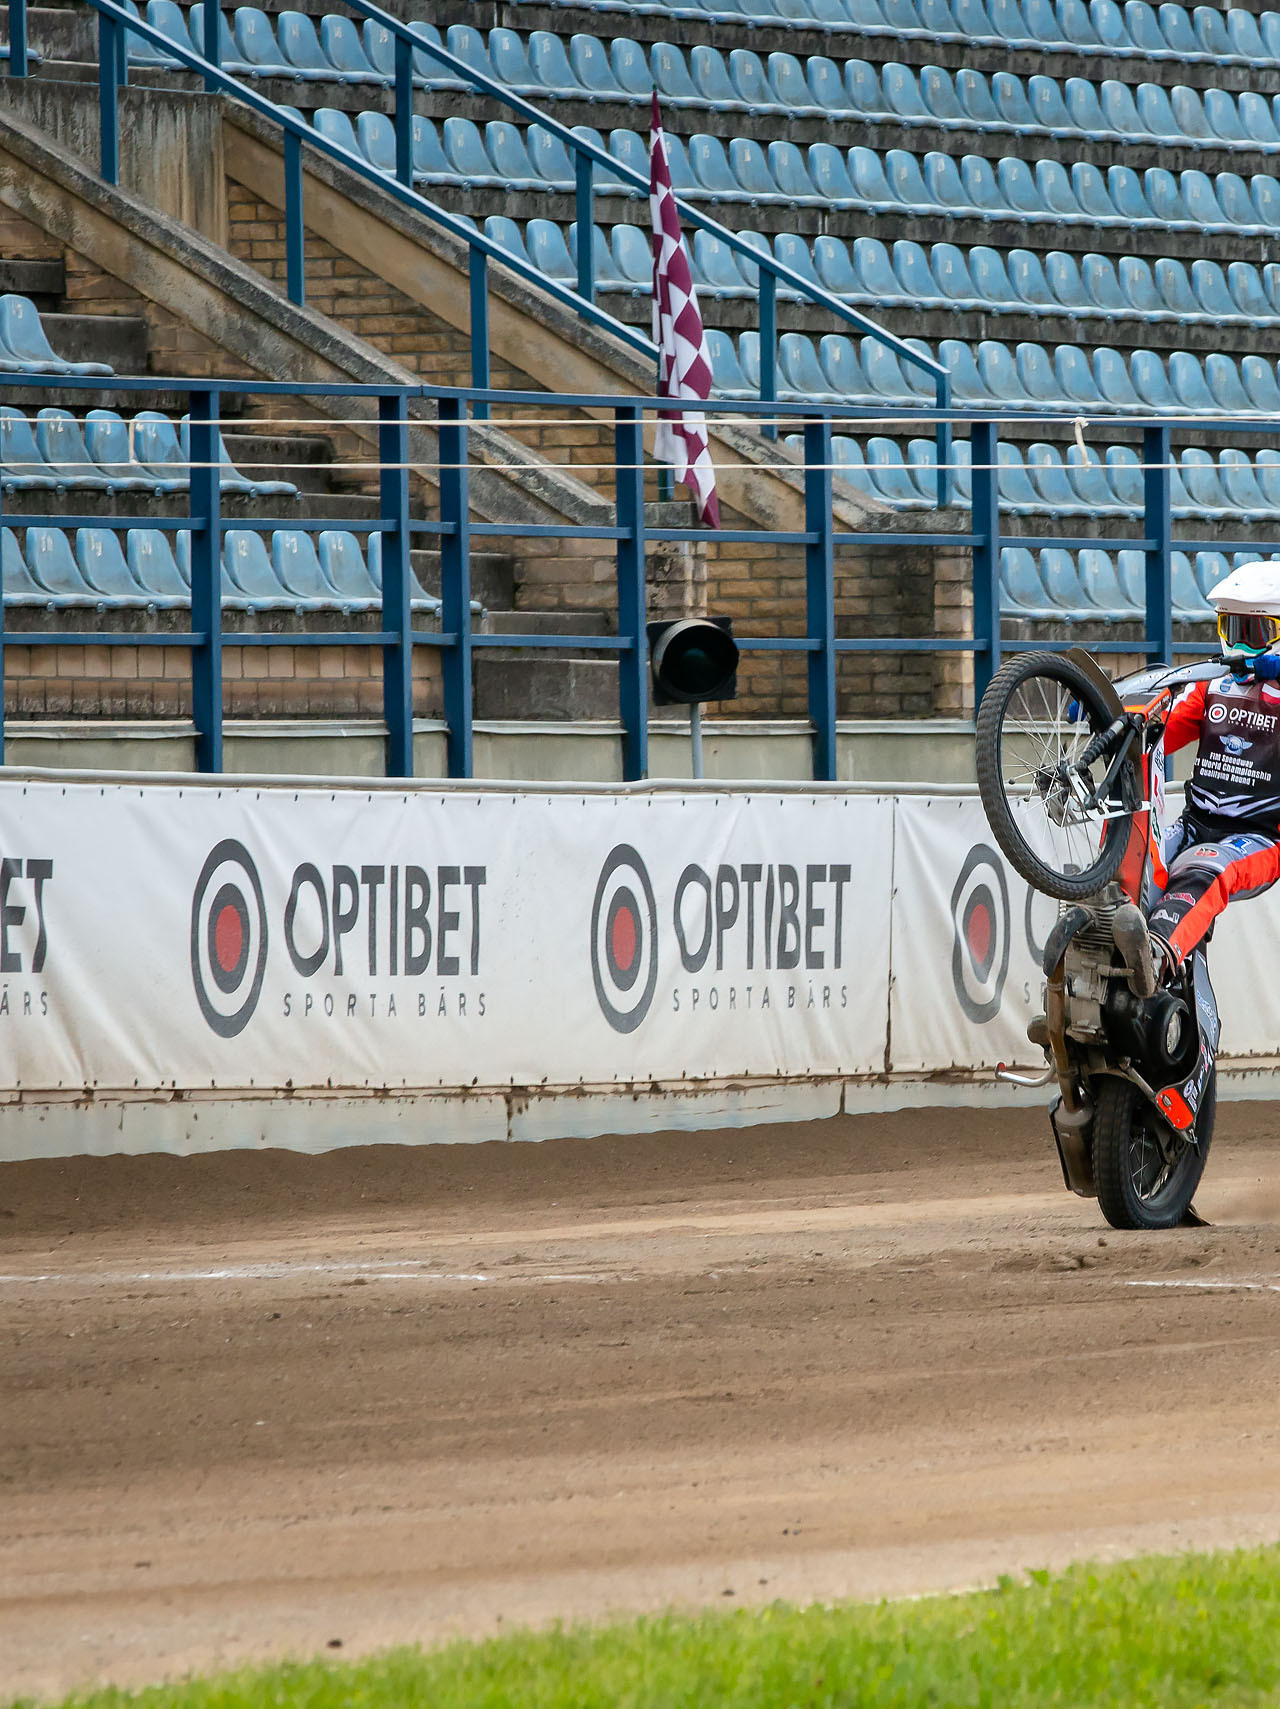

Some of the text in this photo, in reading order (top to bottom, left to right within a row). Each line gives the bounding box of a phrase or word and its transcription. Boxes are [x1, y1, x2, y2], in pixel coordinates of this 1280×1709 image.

[1229, 707, 1278, 729] OPTIBET
[1201, 758, 1222, 771] World
[1222, 762, 1272, 782] Championship
[1209, 751, 1254, 769] FIM Speedway
[1199, 768, 1256, 787] Qualifying Round 1
[284, 862, 486, 977] OPTIBET
[673, 863, 852, 973] OPTIBET
[283, 986, 486, 1017] SPORTA BĀRS
[673, 986, 770, 1012] SPORTA
